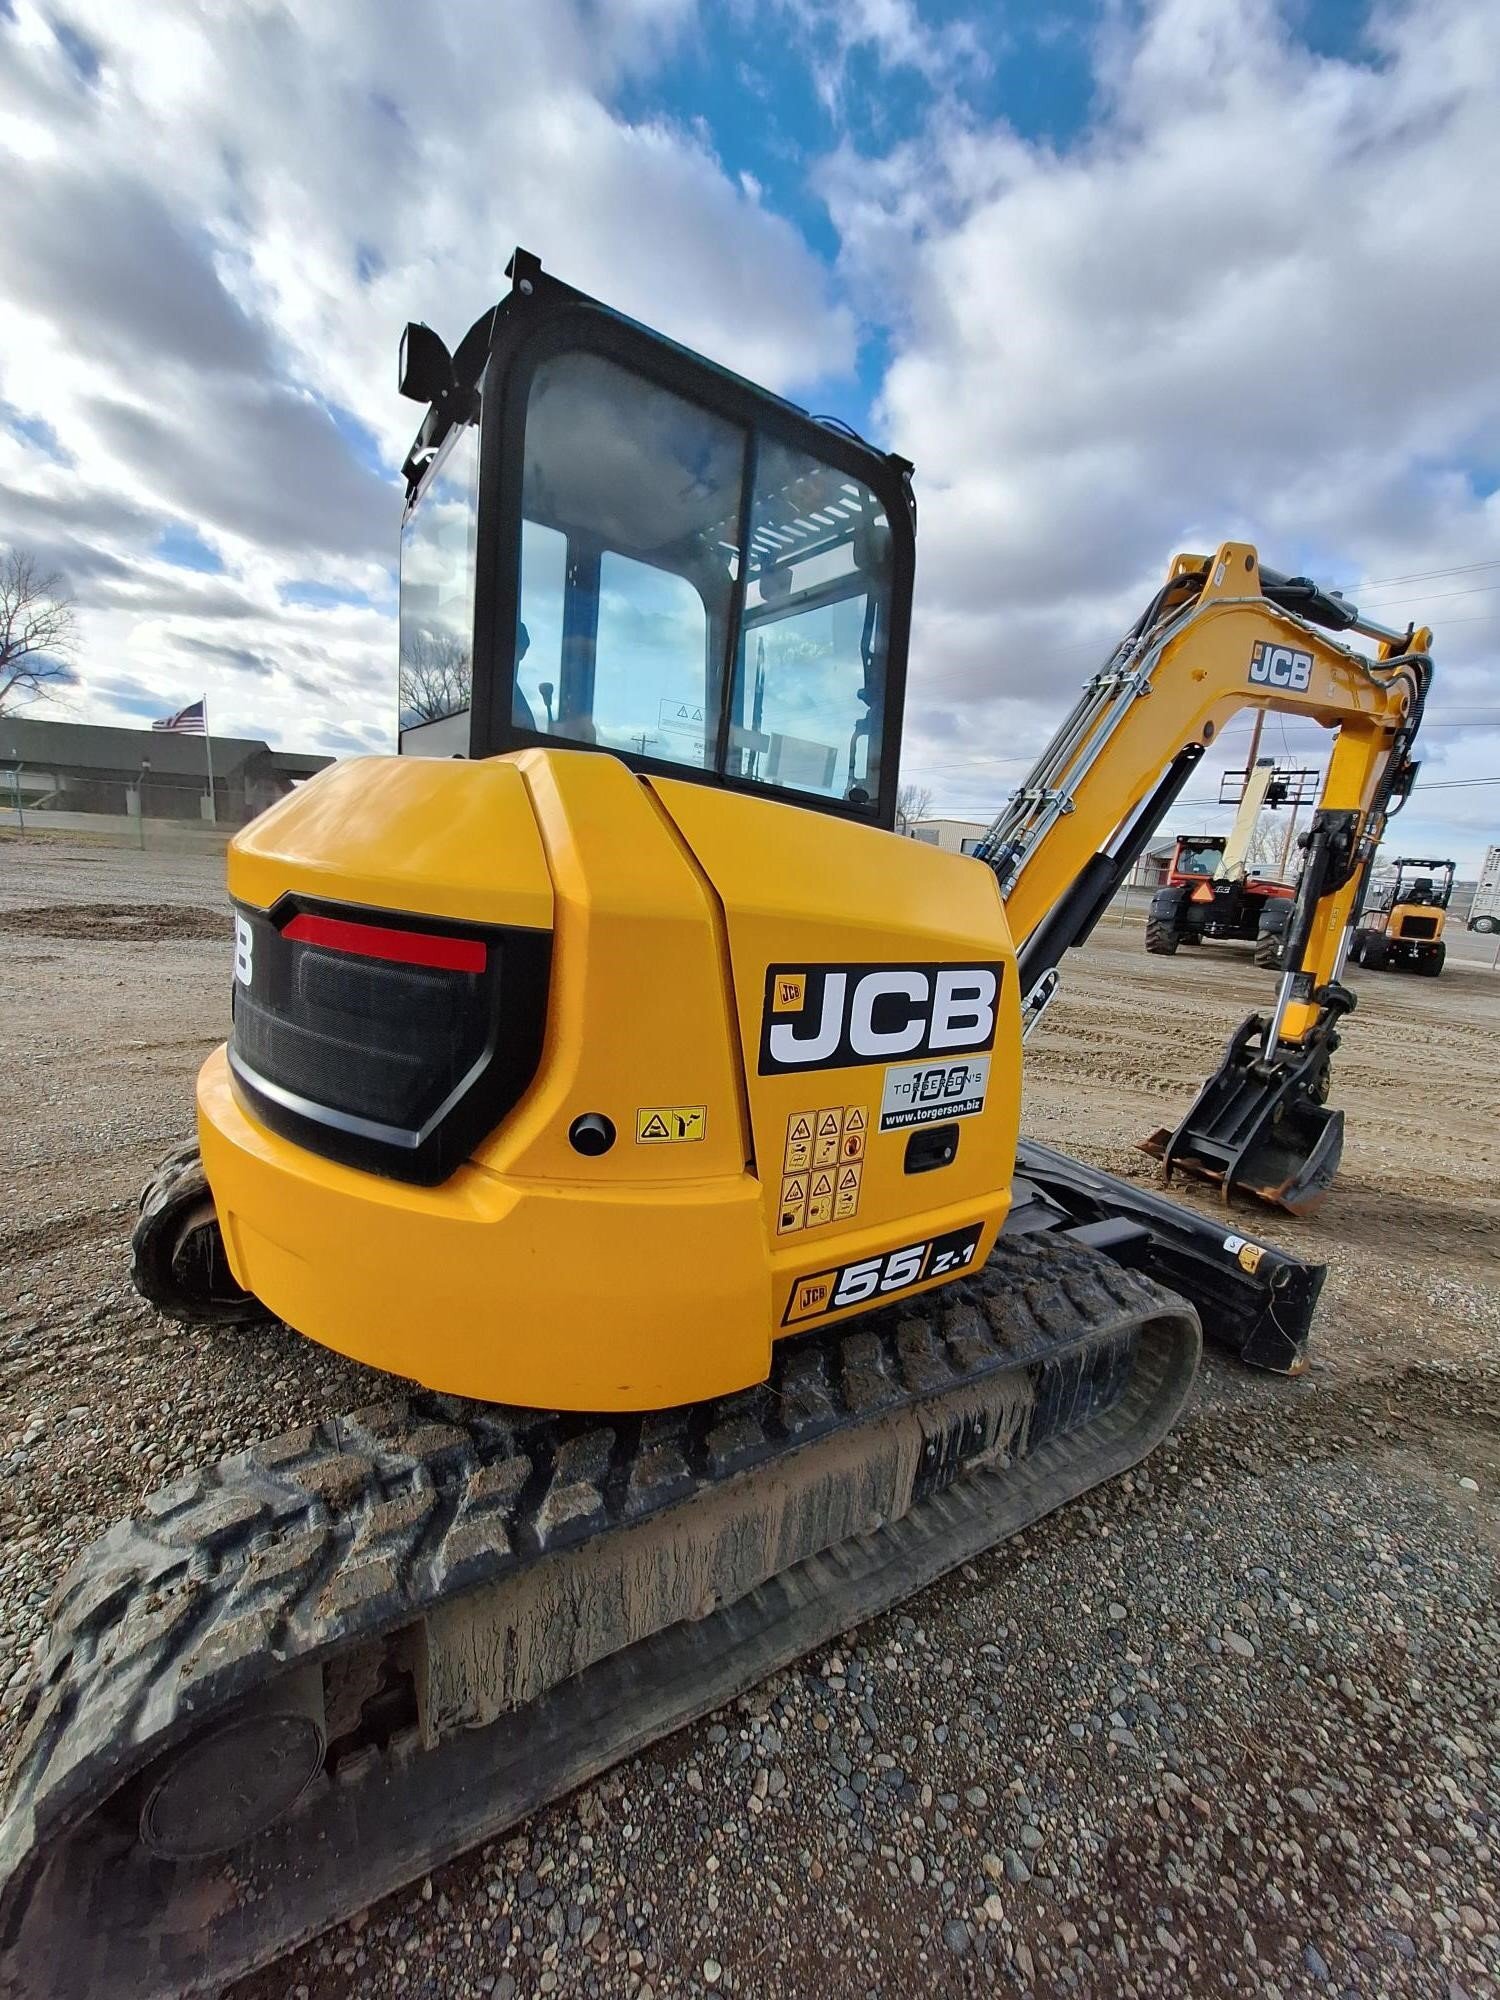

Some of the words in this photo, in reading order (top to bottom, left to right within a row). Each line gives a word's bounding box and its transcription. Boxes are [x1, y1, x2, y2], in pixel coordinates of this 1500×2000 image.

[1251, 646, 1311, 690] JCB
[769, 969, 997, 1064] JCB
[894, 1073, 981, 1095] TORGERSON'S
[910, 1066, 969, 1103] 100
[886, 1100, 980, 1126] www.torgerson.biz
[834, 1244, 925, 1307] 55
